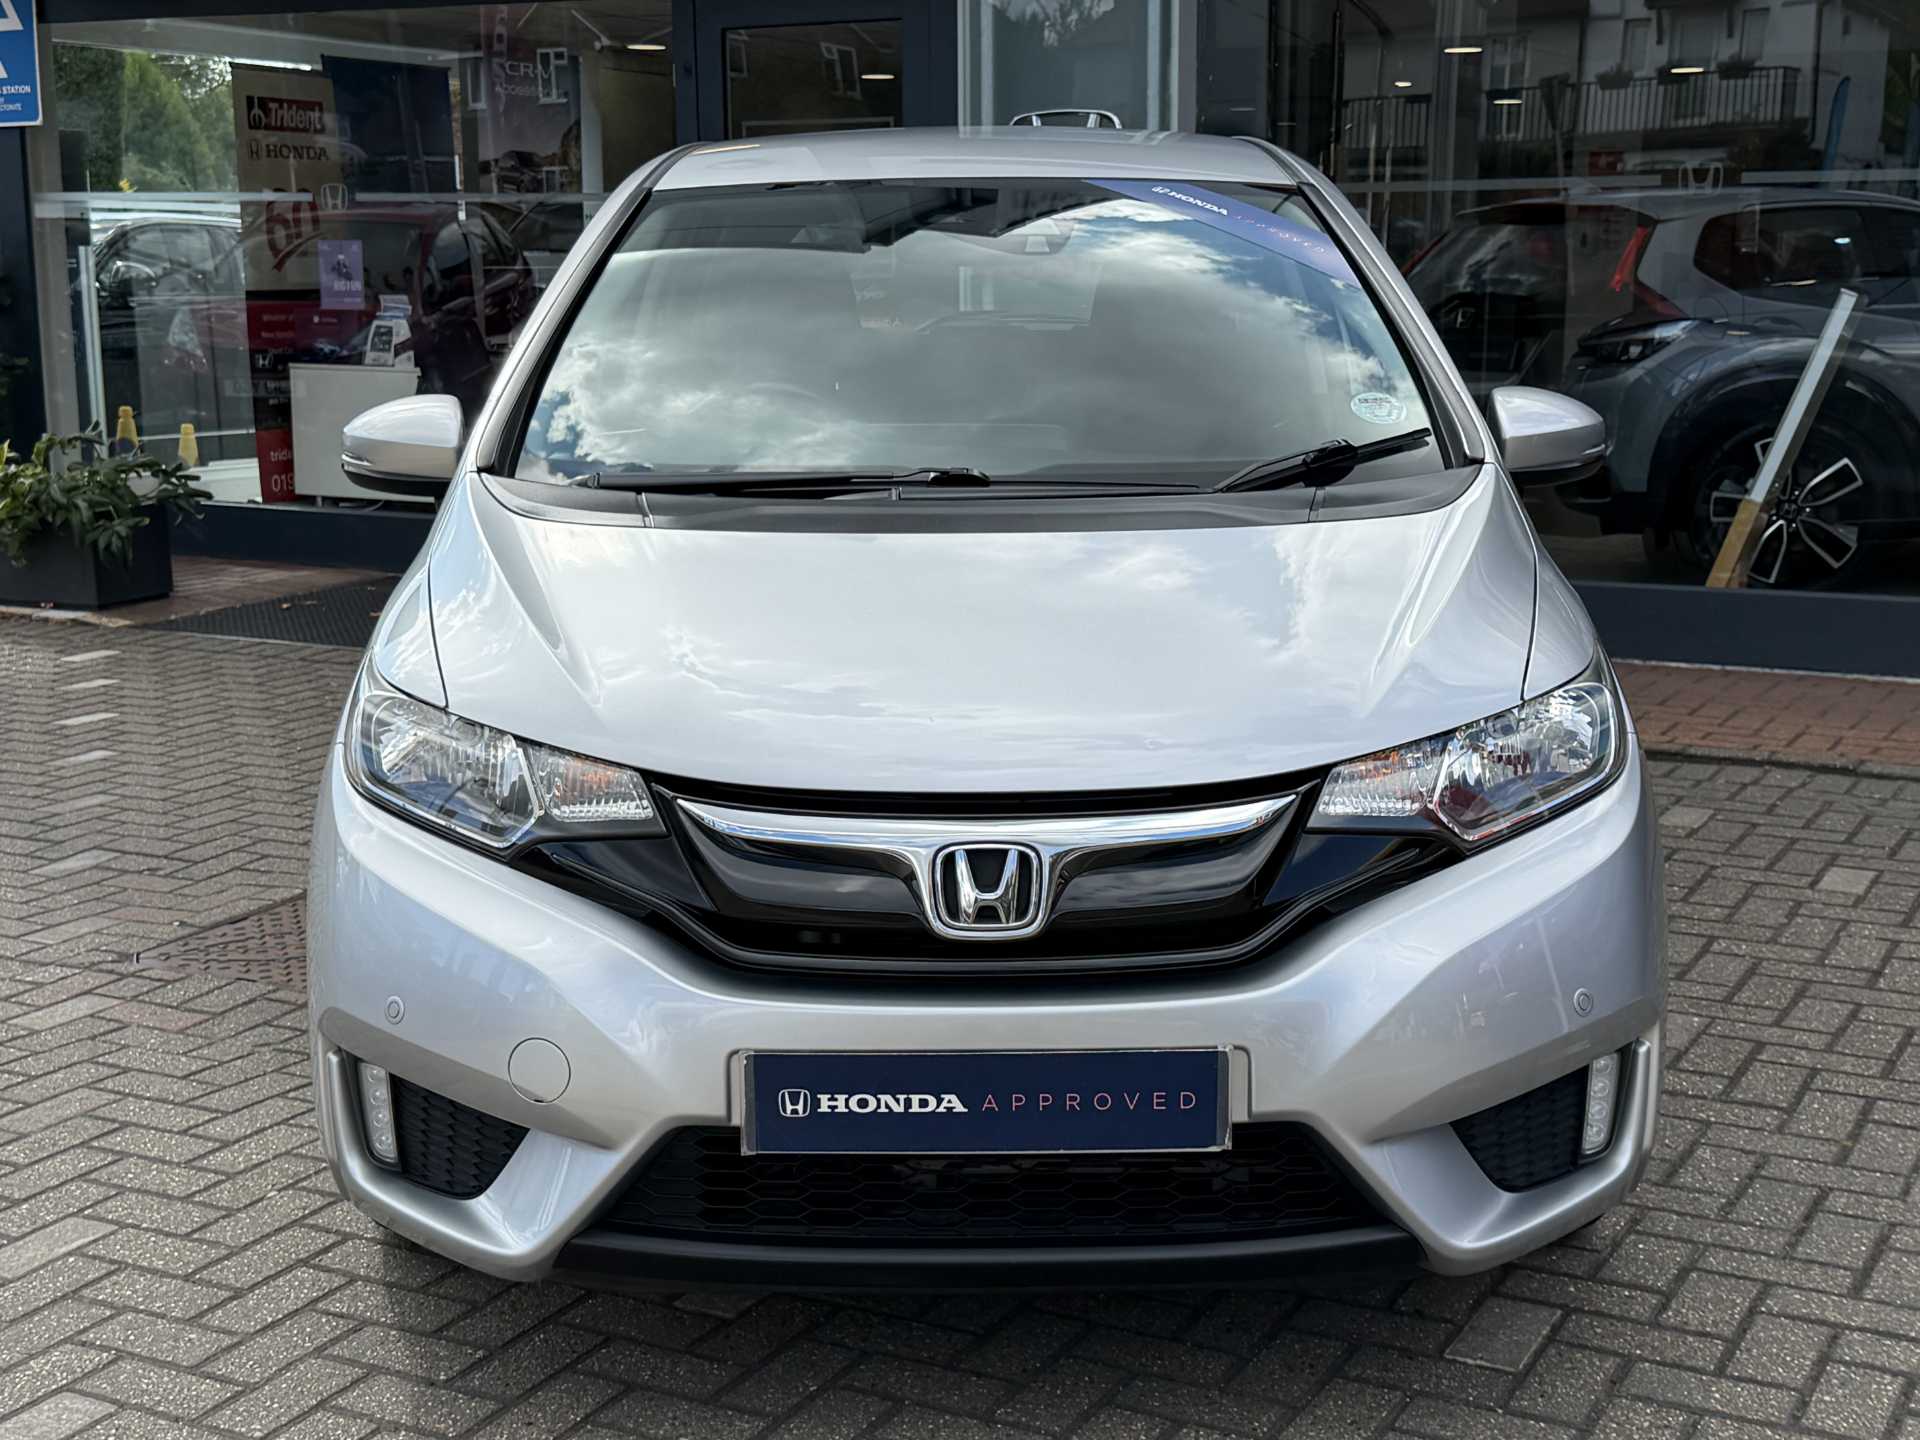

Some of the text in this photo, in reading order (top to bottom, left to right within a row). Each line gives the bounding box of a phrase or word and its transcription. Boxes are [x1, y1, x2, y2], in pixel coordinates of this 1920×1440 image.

[2, 85, 31, 95] STATION
[268, 101, 322, 132] Trident
[265, 142, 329, 161] HONDA
[816, 1093, 969, 1114] HONDA
[981, 1091, 1197, 1112] APPROVED
